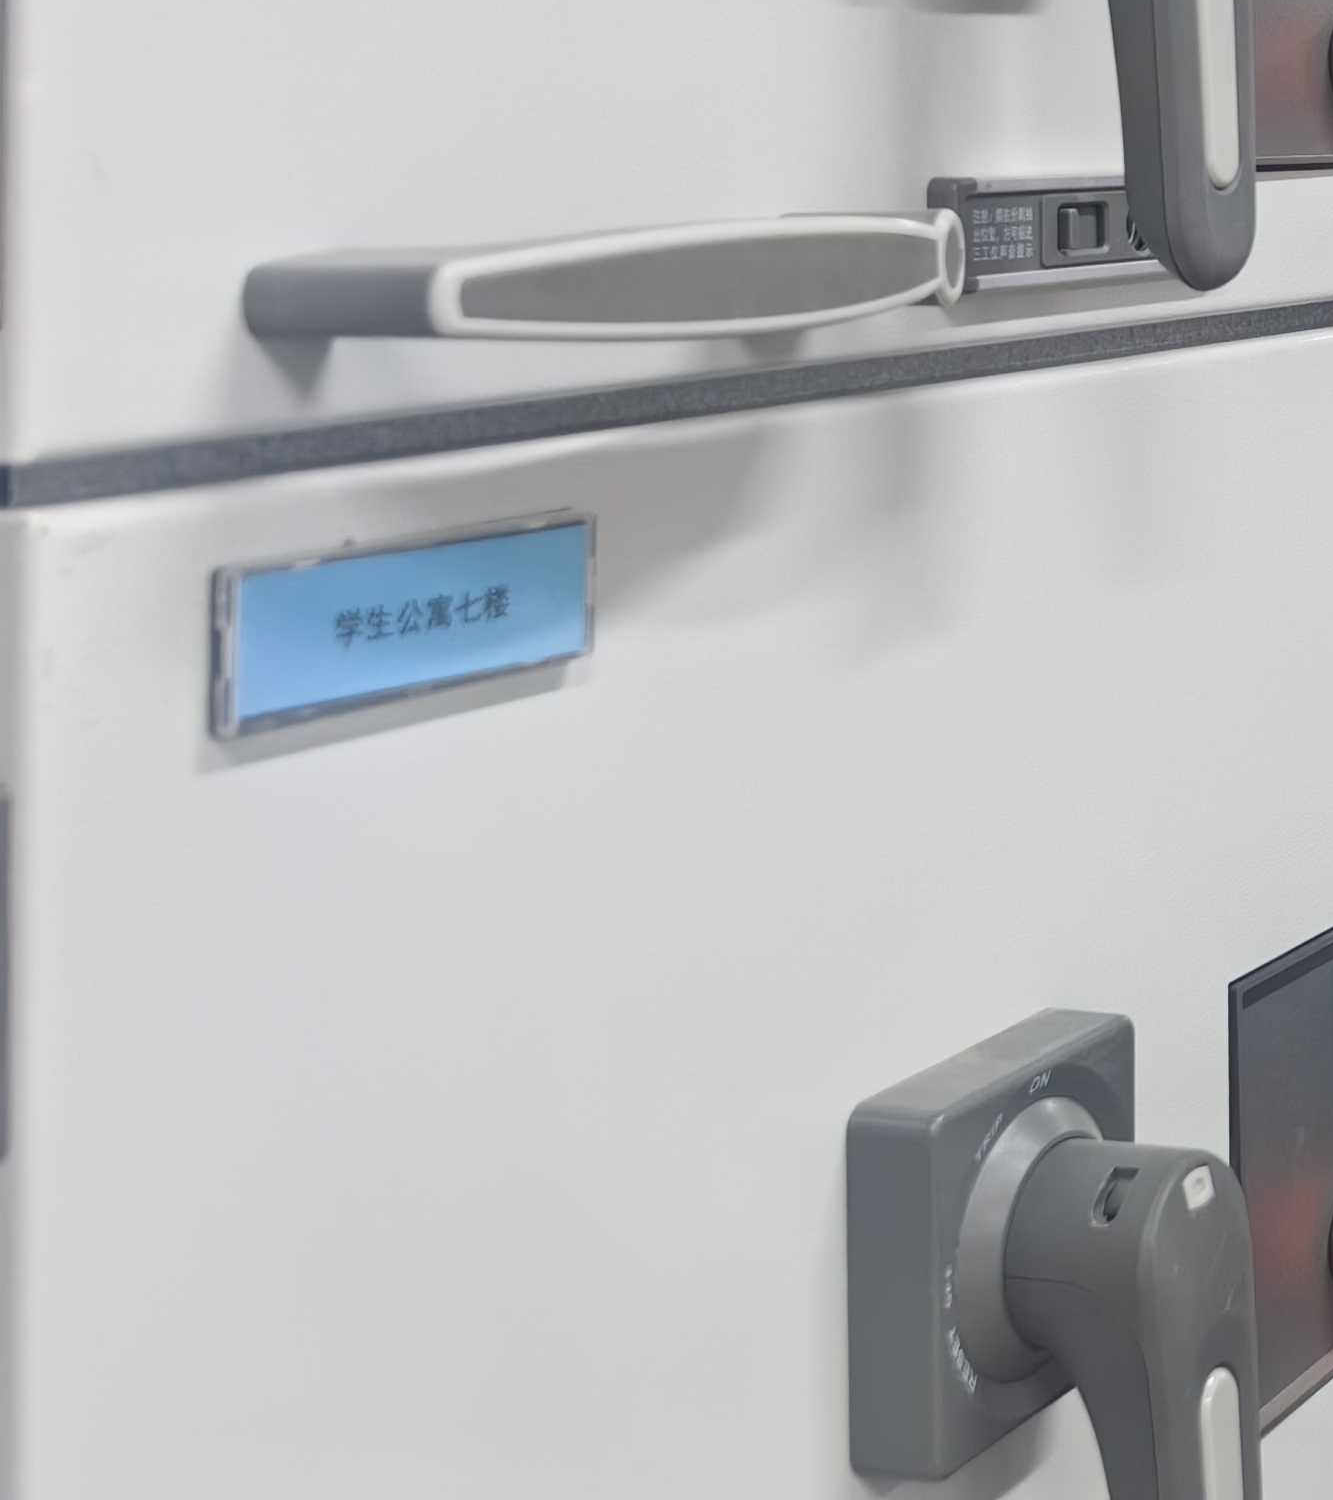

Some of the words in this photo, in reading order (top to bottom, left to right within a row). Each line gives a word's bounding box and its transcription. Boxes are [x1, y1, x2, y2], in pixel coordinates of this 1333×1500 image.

[335, 583, 511, 647] 学生公寓七楼
